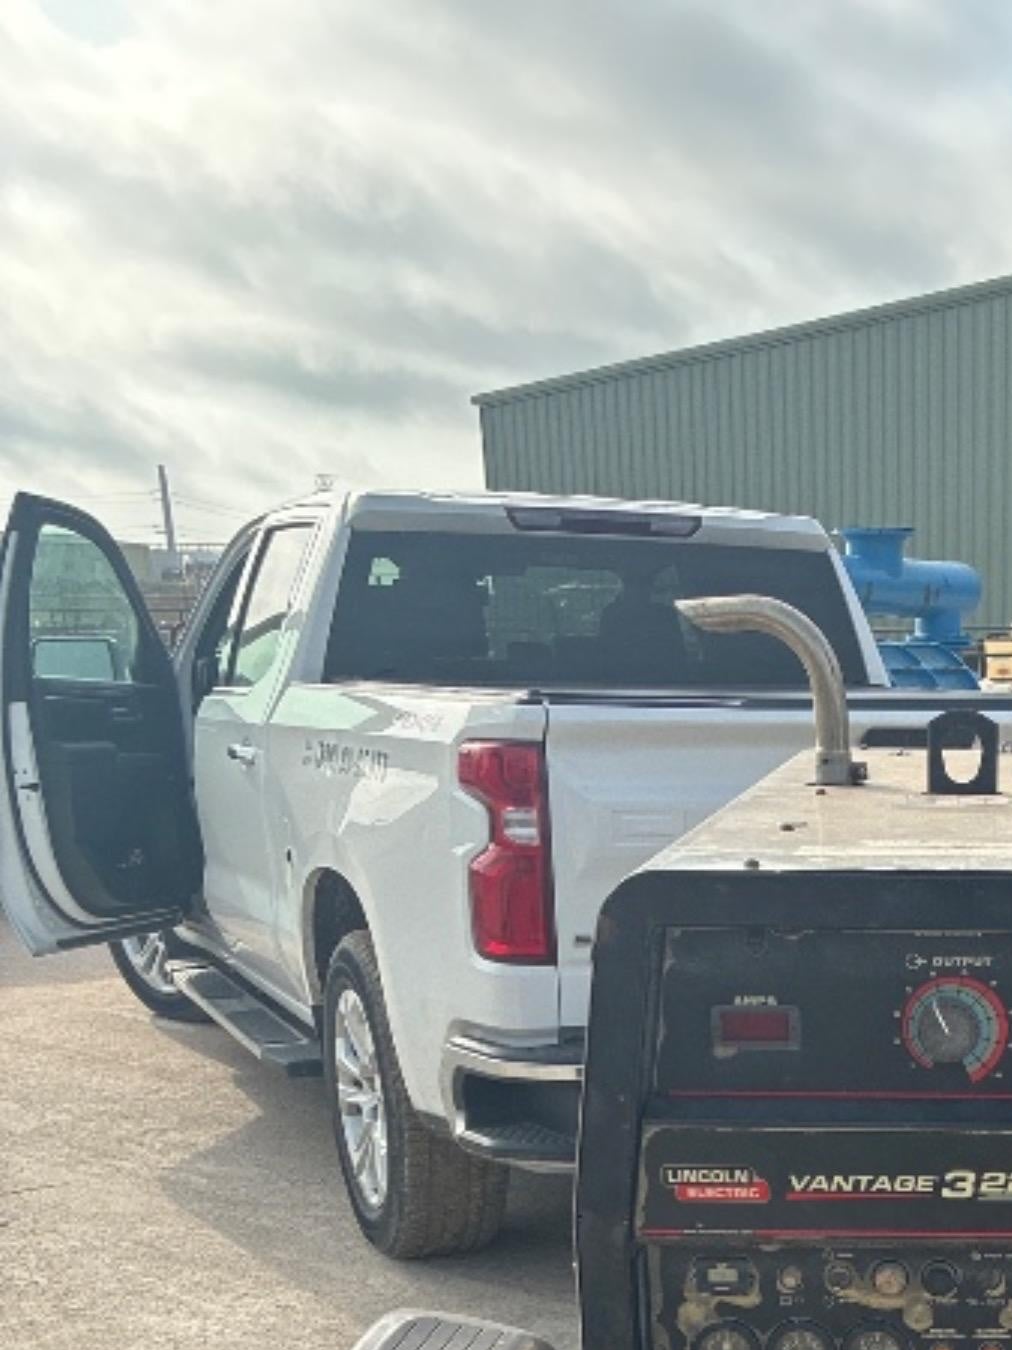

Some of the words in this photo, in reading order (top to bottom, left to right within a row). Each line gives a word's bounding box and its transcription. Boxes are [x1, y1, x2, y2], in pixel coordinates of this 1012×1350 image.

[932, 956, 993, 967] OUTPUT
[666, 1169, 749, 1184] LINCOLN
[788, 1174, 936, 1193] VANTAGE
[686, 1186, 761, 1199] ELECTRIC
